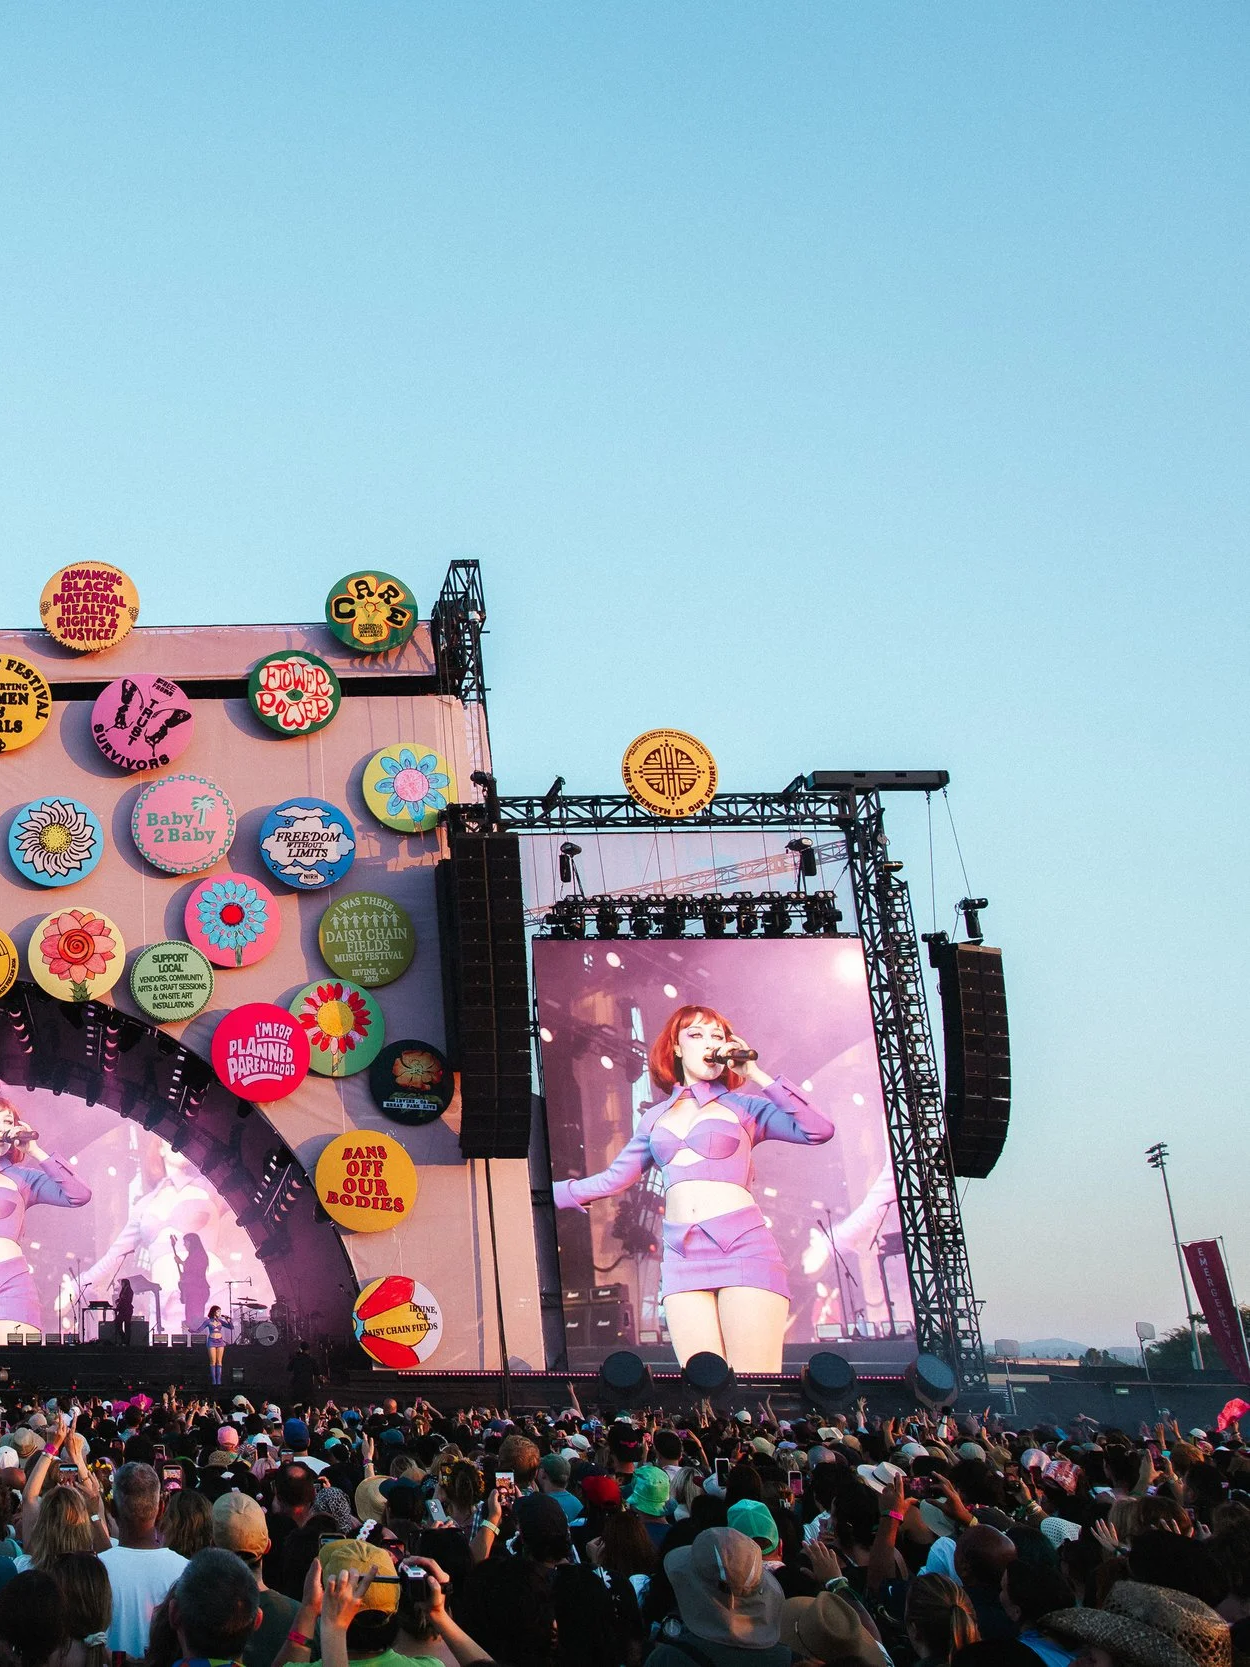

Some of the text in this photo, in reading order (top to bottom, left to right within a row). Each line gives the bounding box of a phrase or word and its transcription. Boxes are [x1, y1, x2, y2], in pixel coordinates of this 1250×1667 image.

[61, 570, 122, 586] ADVANCING
[61, 581, 114, 593] BLACK
[53, 592, 126, 608] MATERNAL
[334, 580, 407, 626] CARE
[62, 604, 120, 619] HEALTH,
[57, 616, 118, 629] RIGHTS &
[61, 628, 116, 641] JUSTICE!
[6, 659, 49, 720] FESTIVAL
[152, 683, 173, 697] FROM
[156, 678, 177, 691] FREE
[258, 697, 329, 727] POWER
[128, 699, 159, 746] TRUST
[94, 724, 170, 770] SURVIVORS
[624, 766, 632, 783] HER
[628, 785, 670, 815] STRENGTH
[688, 799, 705, 812] OUR
[705, 765, 716, 798] FUTURE
[147, 811, 194, 828] Baby
[275, 832, 341, 842] FREEDOM
[287, 849, 328, 858] LIMITS
[340, 897, 361, 910] WAS
[362, 897, 394, 912] THERE
[326, 928, 407, 943] DAISY CHAIN
[347, 940, 390, 952] FIELDS
[152, 953, 188, 963] SUPPORT
[335, 951, 403, 963] MUSIC FESTIVAL
[159, 964, 183, 973] LOCAL
[140, 975, 168, 983] VENDORS,
[256, 1022, 293, 1040] I'M FOR
[230, 1037, 293, 1062] PLANNED
[227, 1056, 295, 1085] PARENTHOOD
[342, 1146, 387, 1160] BANS
[346, 1160, 384, 1177] OFF
[343, 1178, 389, 1196] OUR
[326, 1191, 404, 1212] BODIES
[1198, 1247, 1231, 1338] EMERGENCY
[410, 1305, 437, 1315] IRVINE,
[386, 1325, 410, 1335] CHAIN
[412, 1323, 438, 1331] FIELDS
